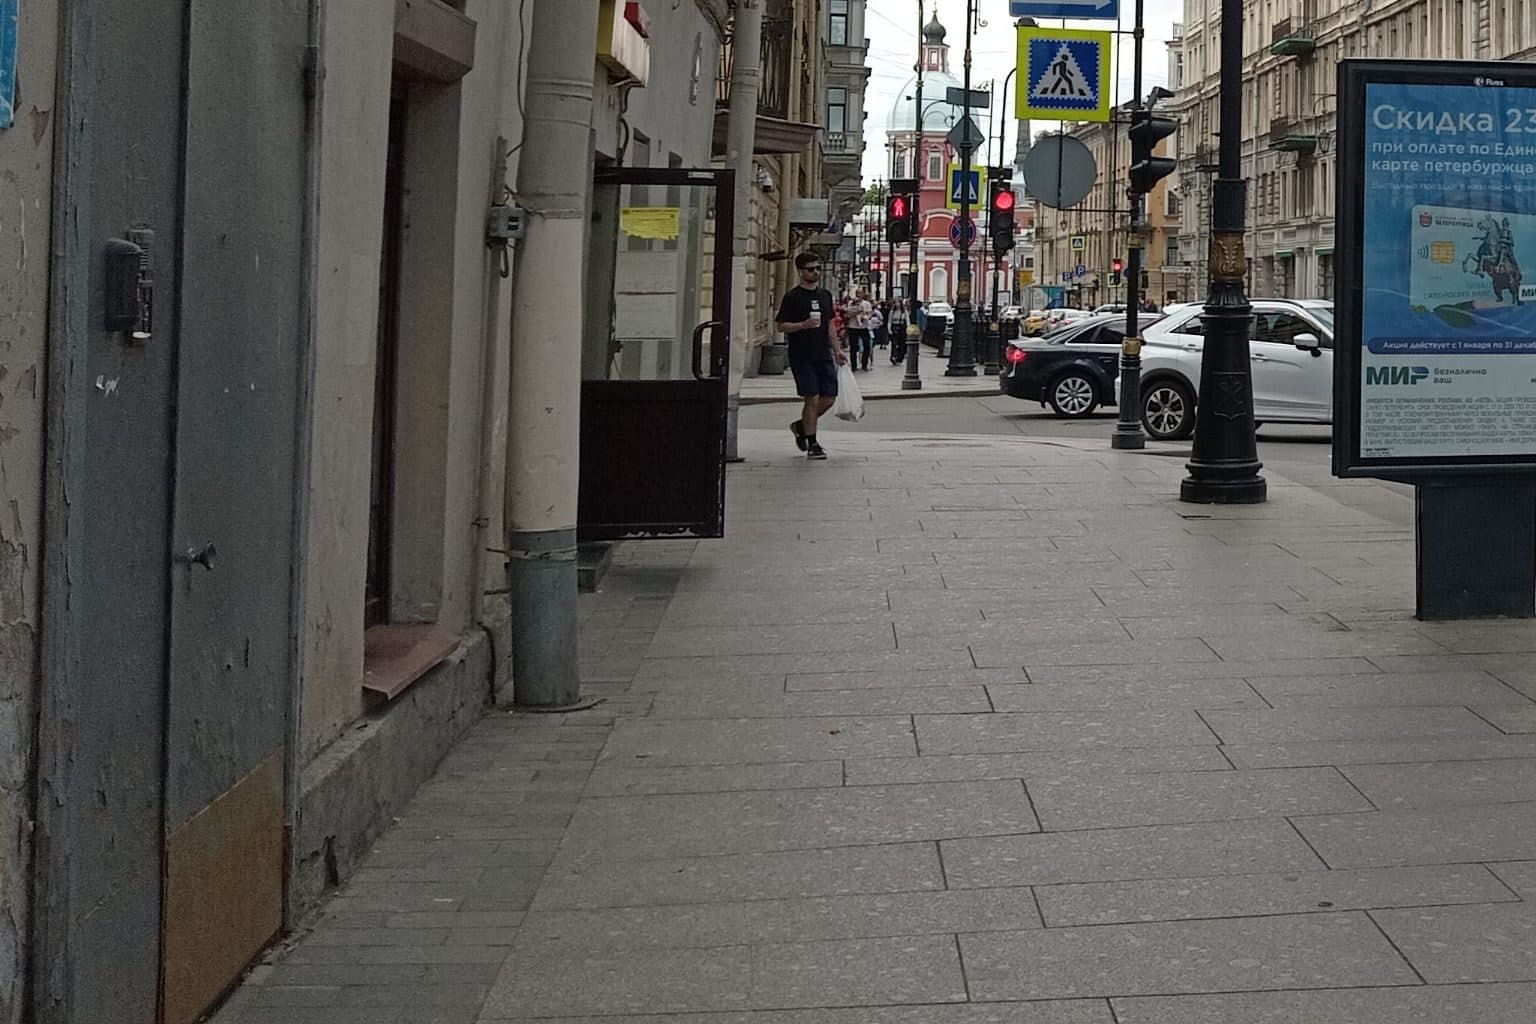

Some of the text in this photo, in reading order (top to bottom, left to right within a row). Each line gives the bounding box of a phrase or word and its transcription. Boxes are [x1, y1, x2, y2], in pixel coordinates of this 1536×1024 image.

[1373, 104, 1493, 135] Скидка
[1372, 142, 1403, 155] при
[1408, 143, 1464, 154] оплате
[1470, 144, 1490, 155] по
[1372, 160, 1534, 175] карте петербуржца
[1383, 341, 1408, 349] Акция
[1410, 341, 1450, 349] действует
[1367, 366, 1429, 385] МИР
